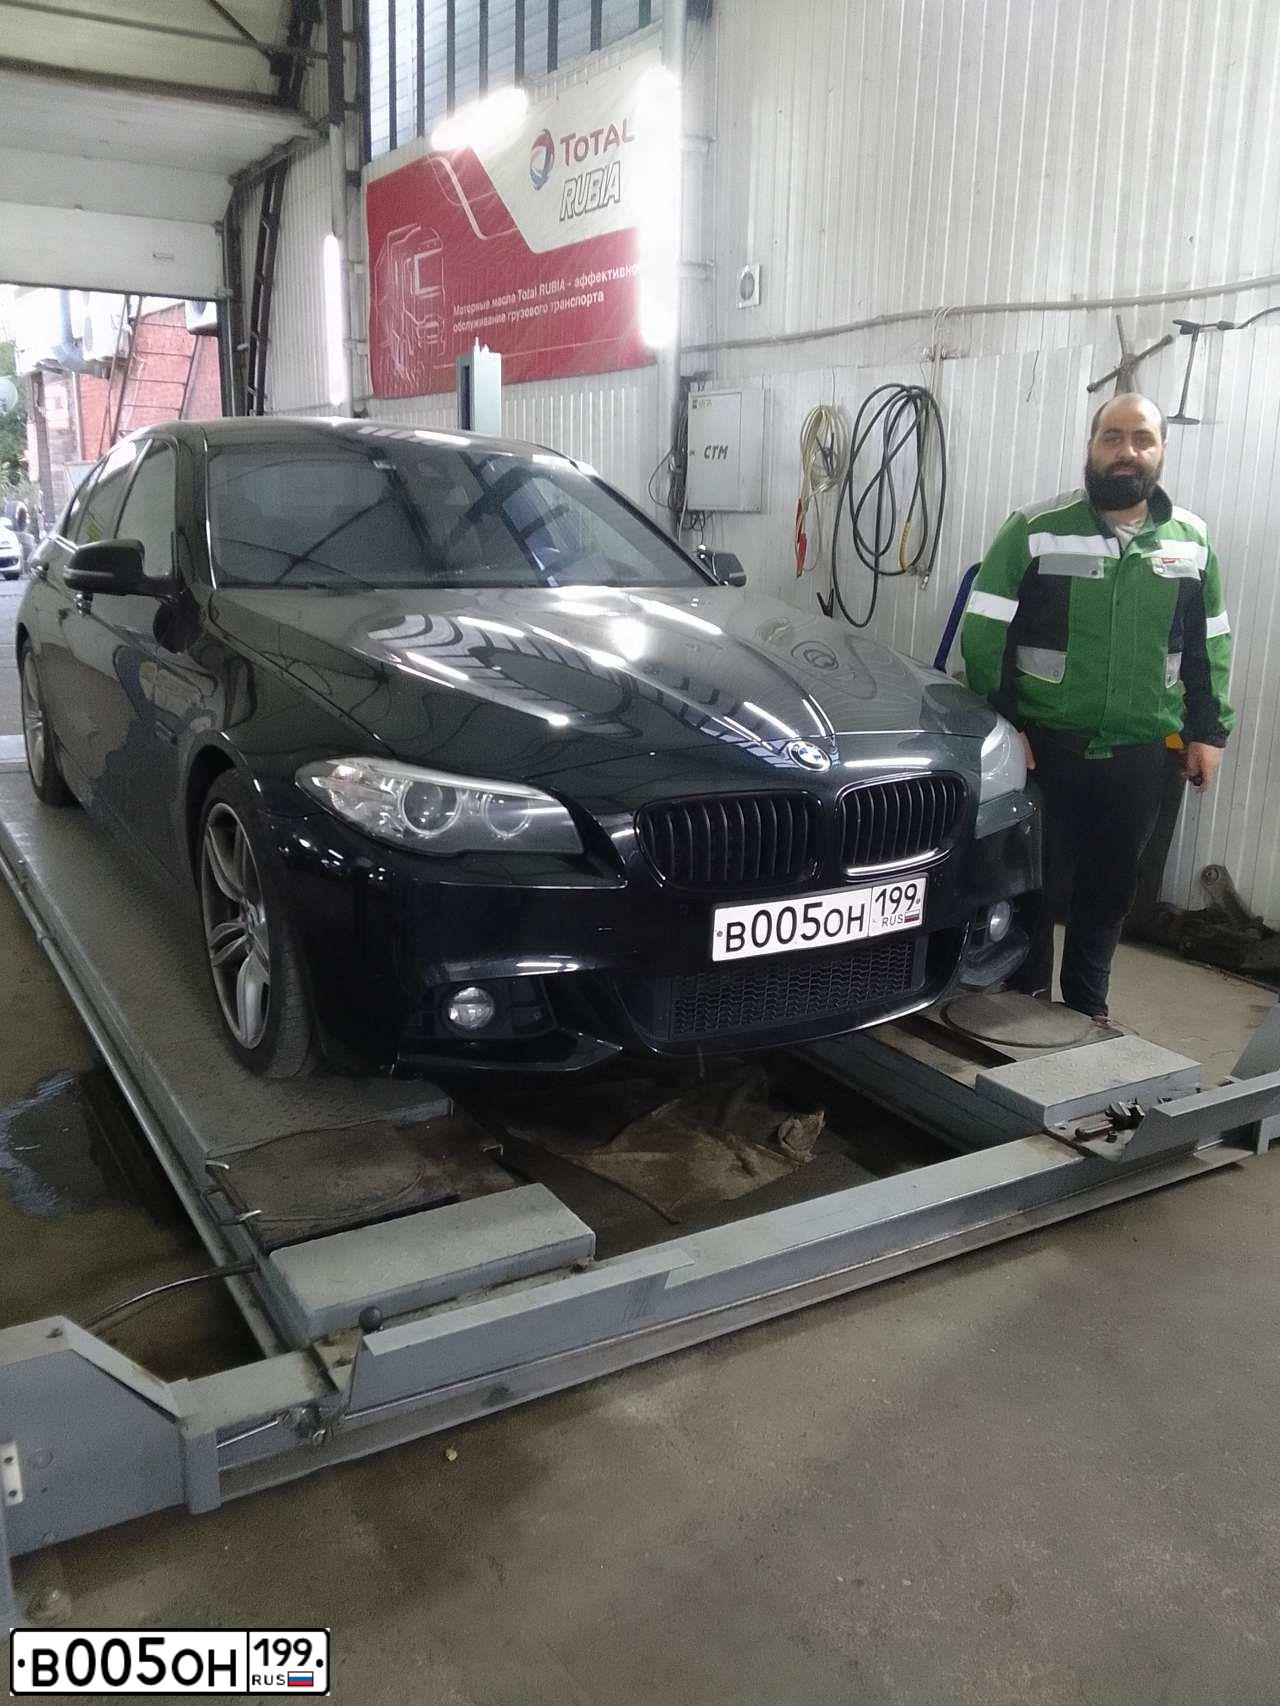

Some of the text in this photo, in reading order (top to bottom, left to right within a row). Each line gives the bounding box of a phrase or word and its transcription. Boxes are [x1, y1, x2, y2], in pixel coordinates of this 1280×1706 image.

[560, 118, 635, 167] TOTAL
[560, 160, 621, 221] RUBIA
[507, 299, 549, 323] грузового
[550, 290, 605, 314] транспорта
[517, 285, 537, 301] Total
[539, 279, 566, 296] RUBIA
[875, 883, 918, 917] 199
[881, 913, 904, 928] RUS
